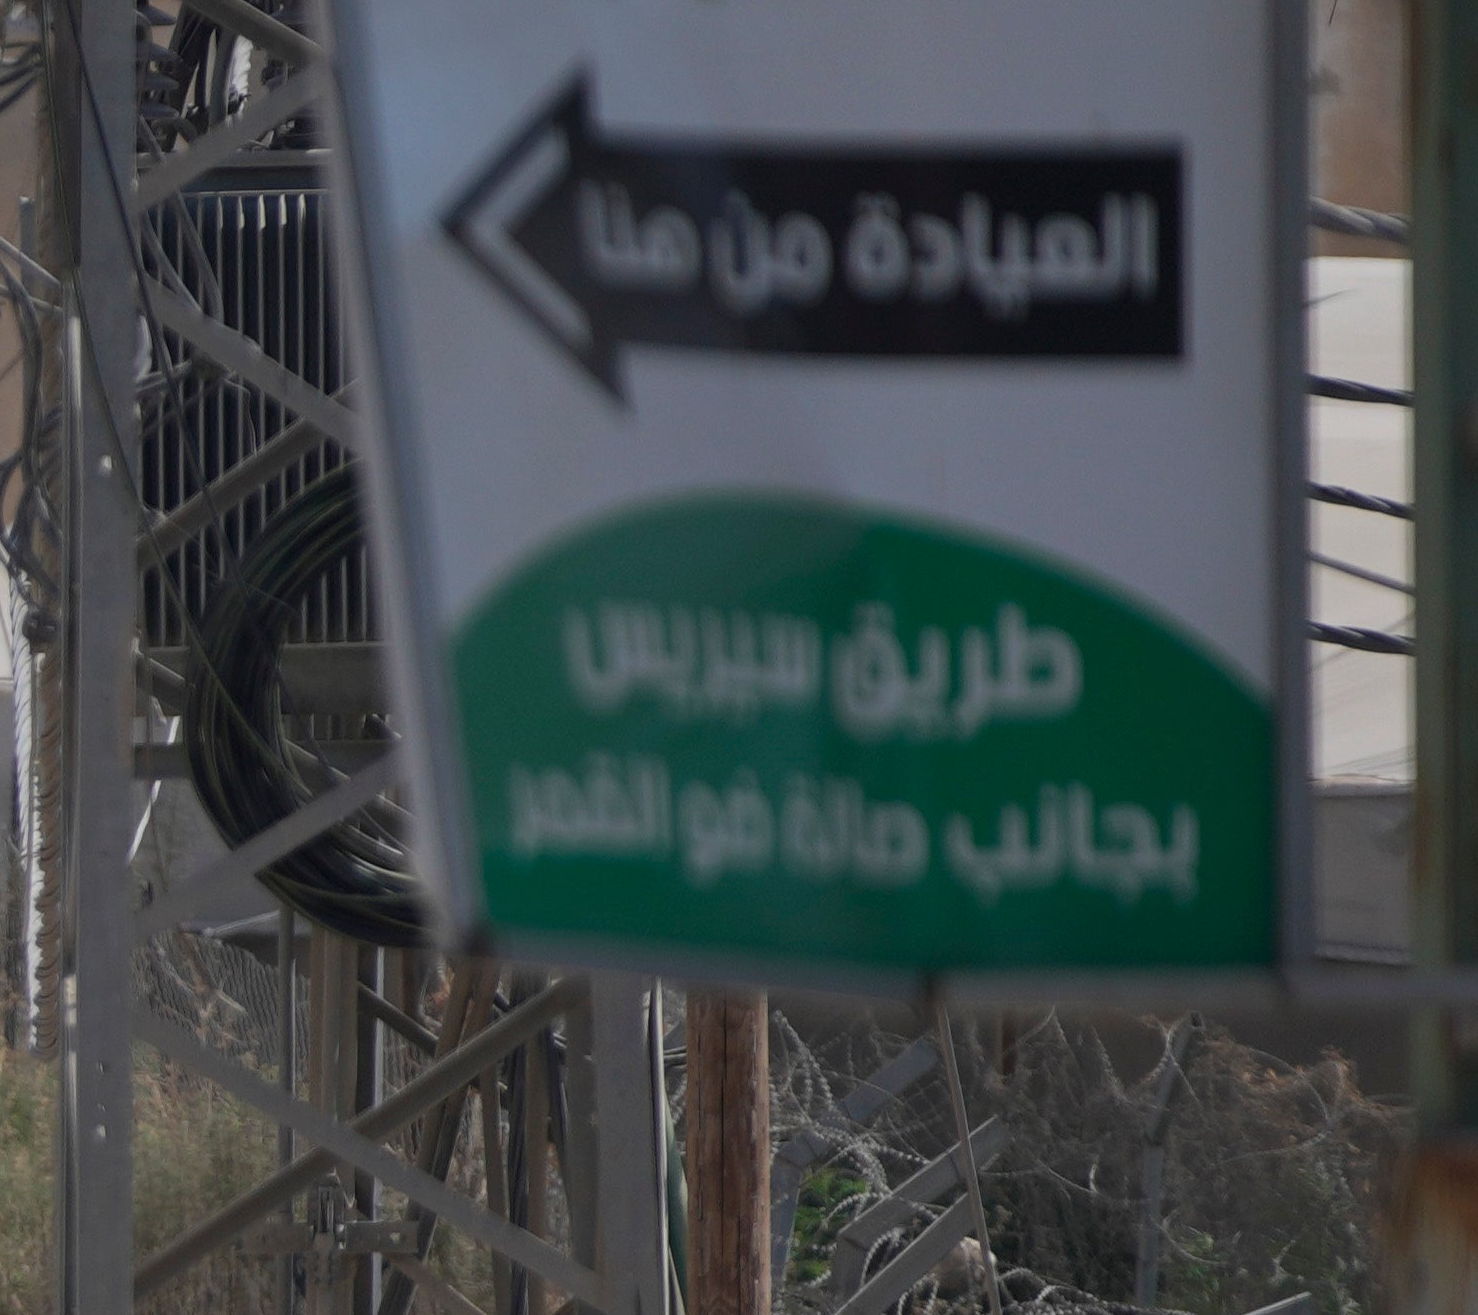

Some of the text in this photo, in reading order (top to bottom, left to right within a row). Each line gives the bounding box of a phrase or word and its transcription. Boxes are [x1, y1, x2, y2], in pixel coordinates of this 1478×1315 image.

[577, 180, 1160, 323] العيادة من هنا
[830, 600, 1084, 743] طريق
[780, 773, 930, 886] صالة
[943, 781, 1201, 908] بجانب
